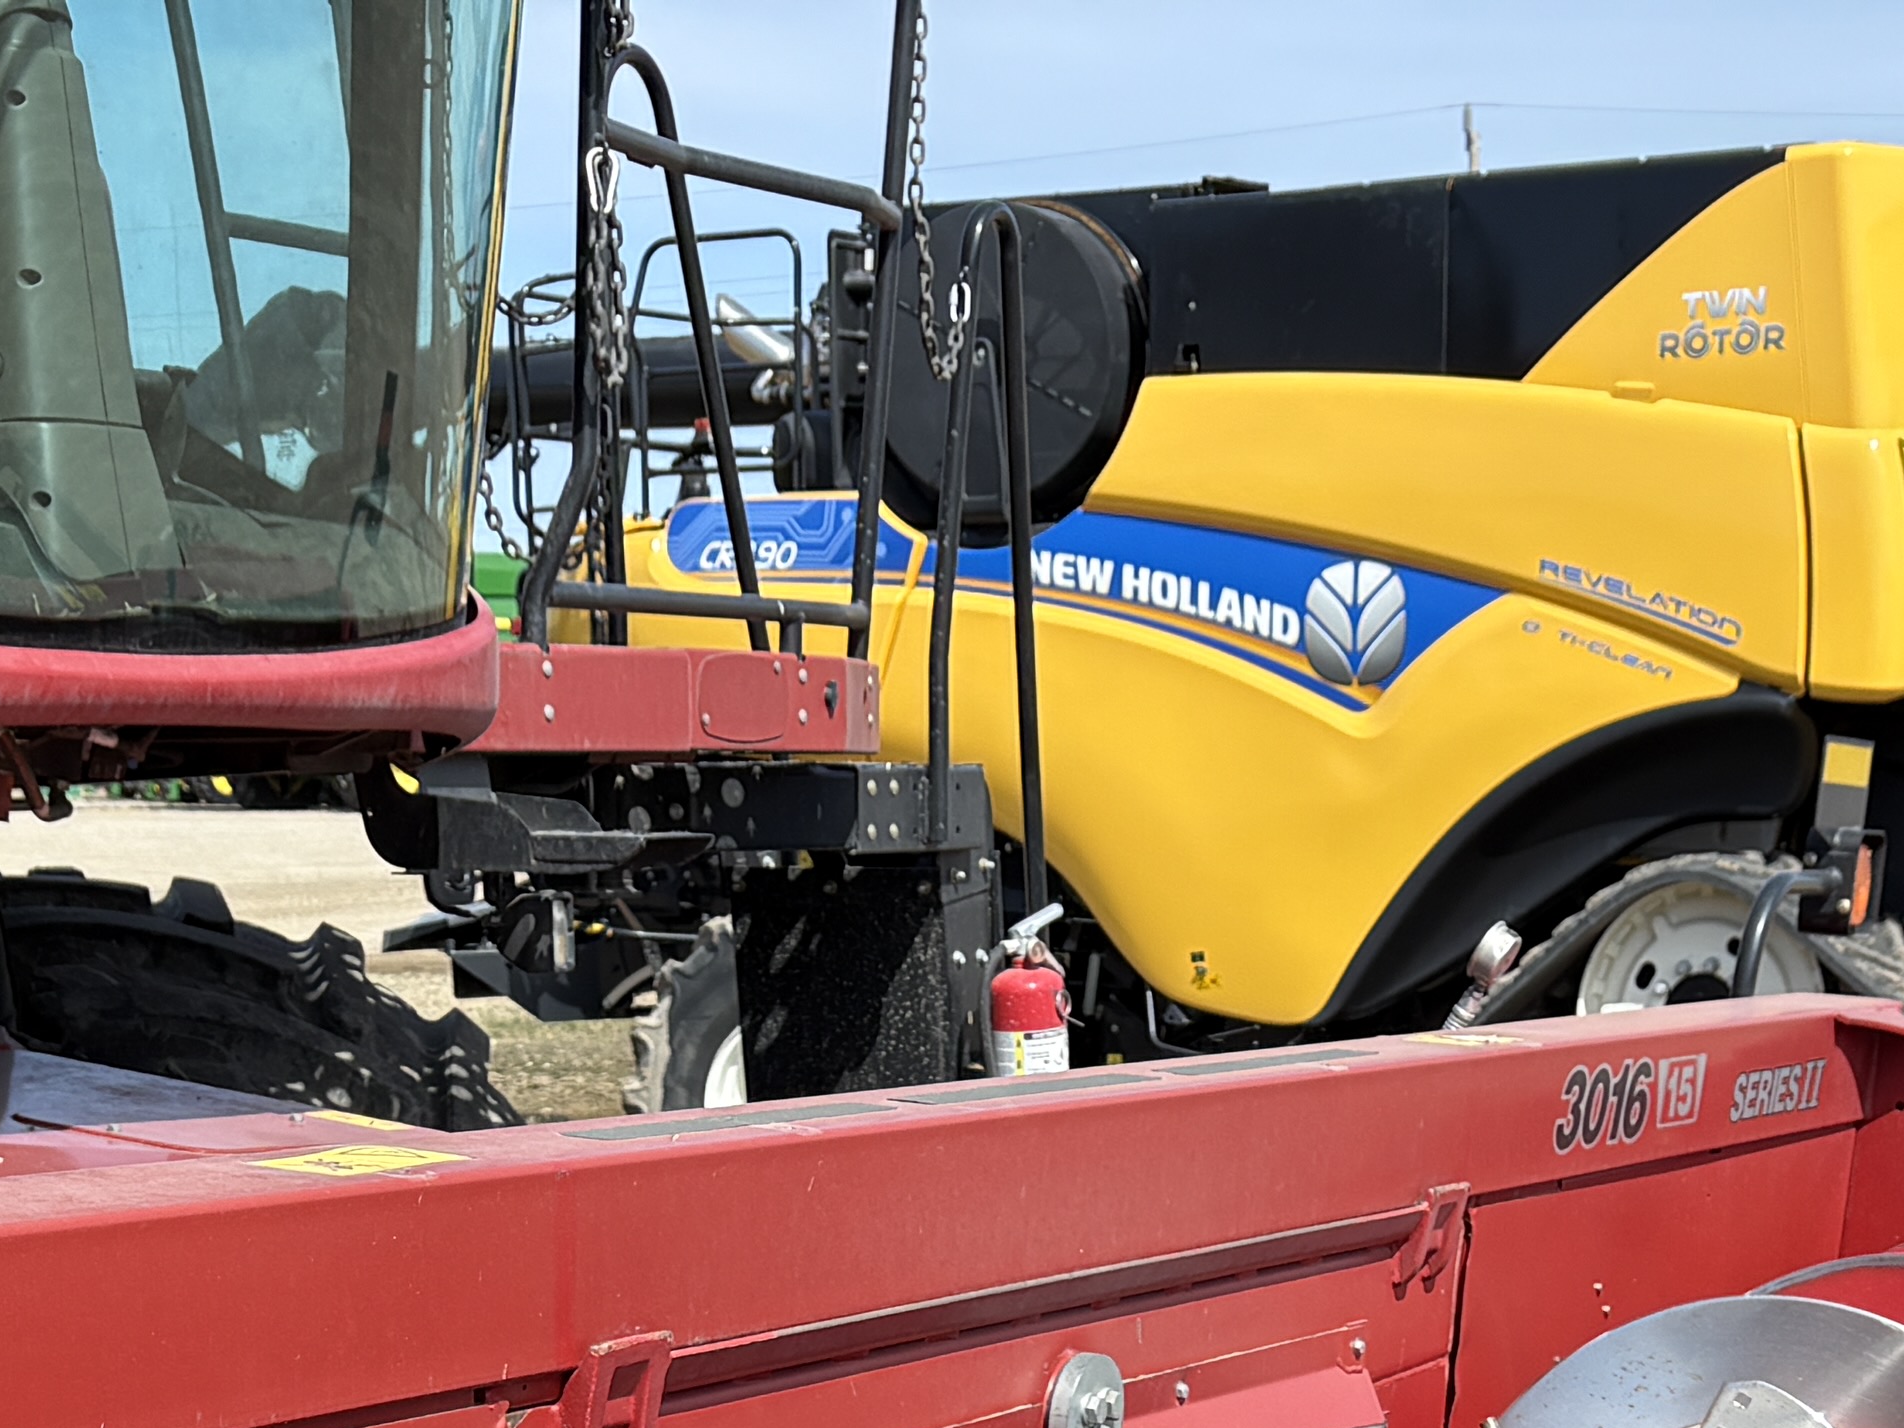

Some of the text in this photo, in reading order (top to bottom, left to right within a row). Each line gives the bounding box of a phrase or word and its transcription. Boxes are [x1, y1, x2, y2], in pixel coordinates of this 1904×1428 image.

[1658, 318, 1786, 359] ROTOR
[1681, 285, 1767, 319] TWIN
[1030, 550, 1301, 647] NEW HOLLAND
[1539, 558, 1744, 645] REVELATION
[1553, 1056, 1828, 1155] 3016 15 SERIES II
